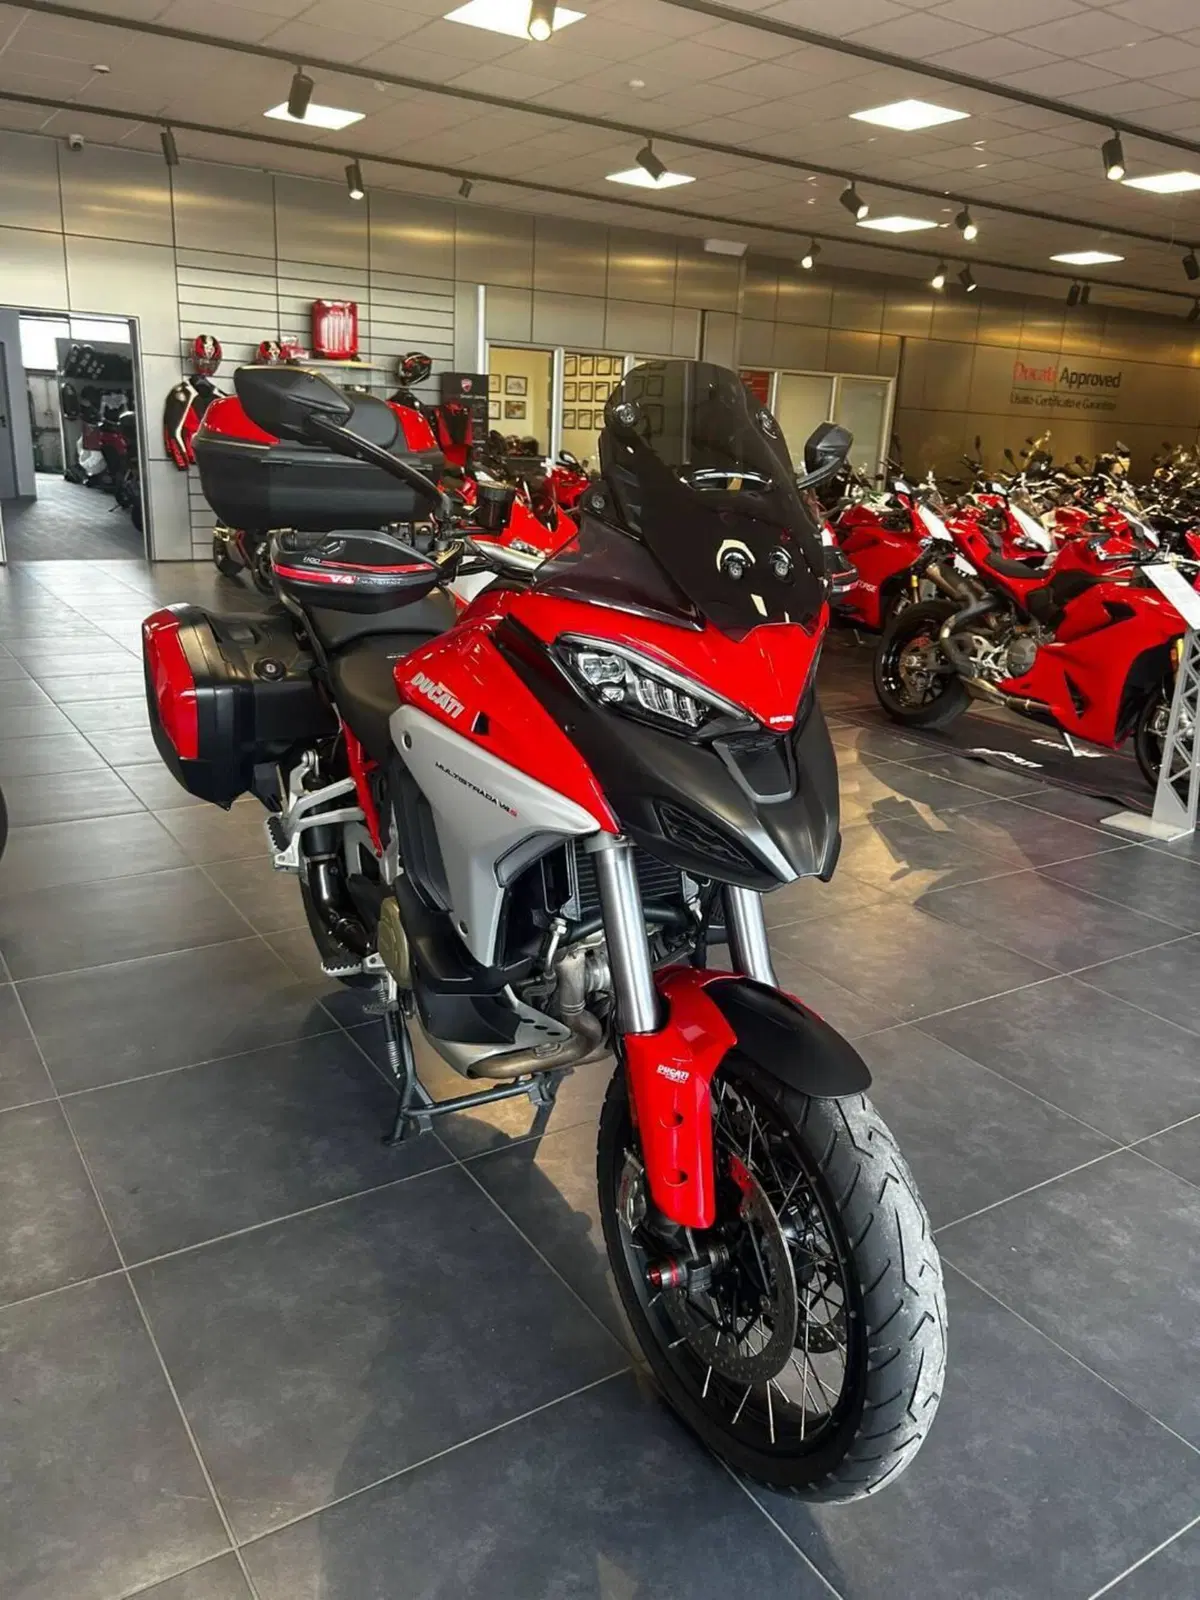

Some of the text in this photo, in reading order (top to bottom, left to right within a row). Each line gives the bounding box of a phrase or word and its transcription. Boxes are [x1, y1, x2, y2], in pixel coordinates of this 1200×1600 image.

[1013, 361, 1122, 389] Ducati Approved
[329, 575, 354, 585] V4
[410, 672, 466, 719] DUCATI
[434, 761, 498, 806] MULTISTRADA
[656, 1064, 690, 1081] DUCATI
